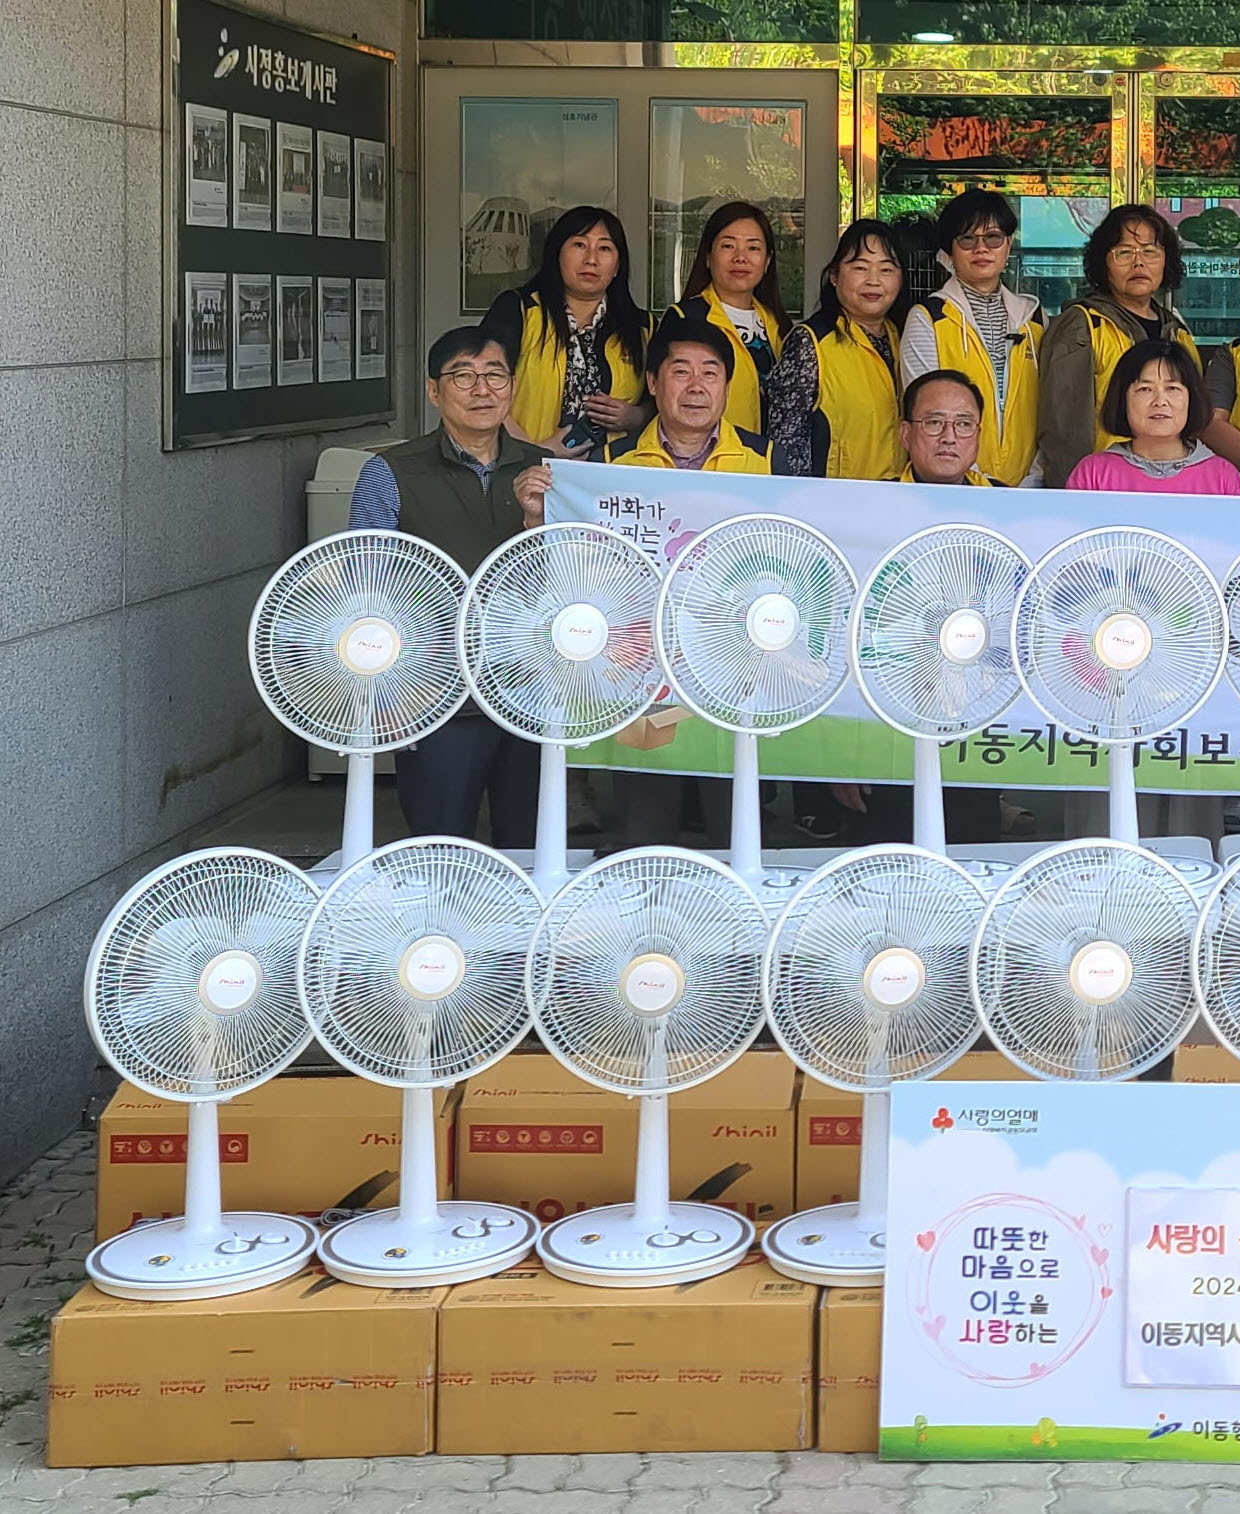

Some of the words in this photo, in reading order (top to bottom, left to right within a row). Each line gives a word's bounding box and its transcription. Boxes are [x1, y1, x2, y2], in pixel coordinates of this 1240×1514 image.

[245, 44, 337, 105] 시정홍보게시판
[599, 496, 666, 521] 매화가
[620, 524, 661, 544] 피는
[958, 1109, 1038, 1126] 사랑의열매
[712, 1125, 777, 1138] Shinil
[973, 1227, 1049, 1252] 따뜻한
[1146, 1224, 1226, 1256] 사랑의
[962, 1256, 1060, 1280] 마음으로
[970, 1290, 1049, 1316] 이웃을
[958, 1320, 1058, 1345] 사랑하는
